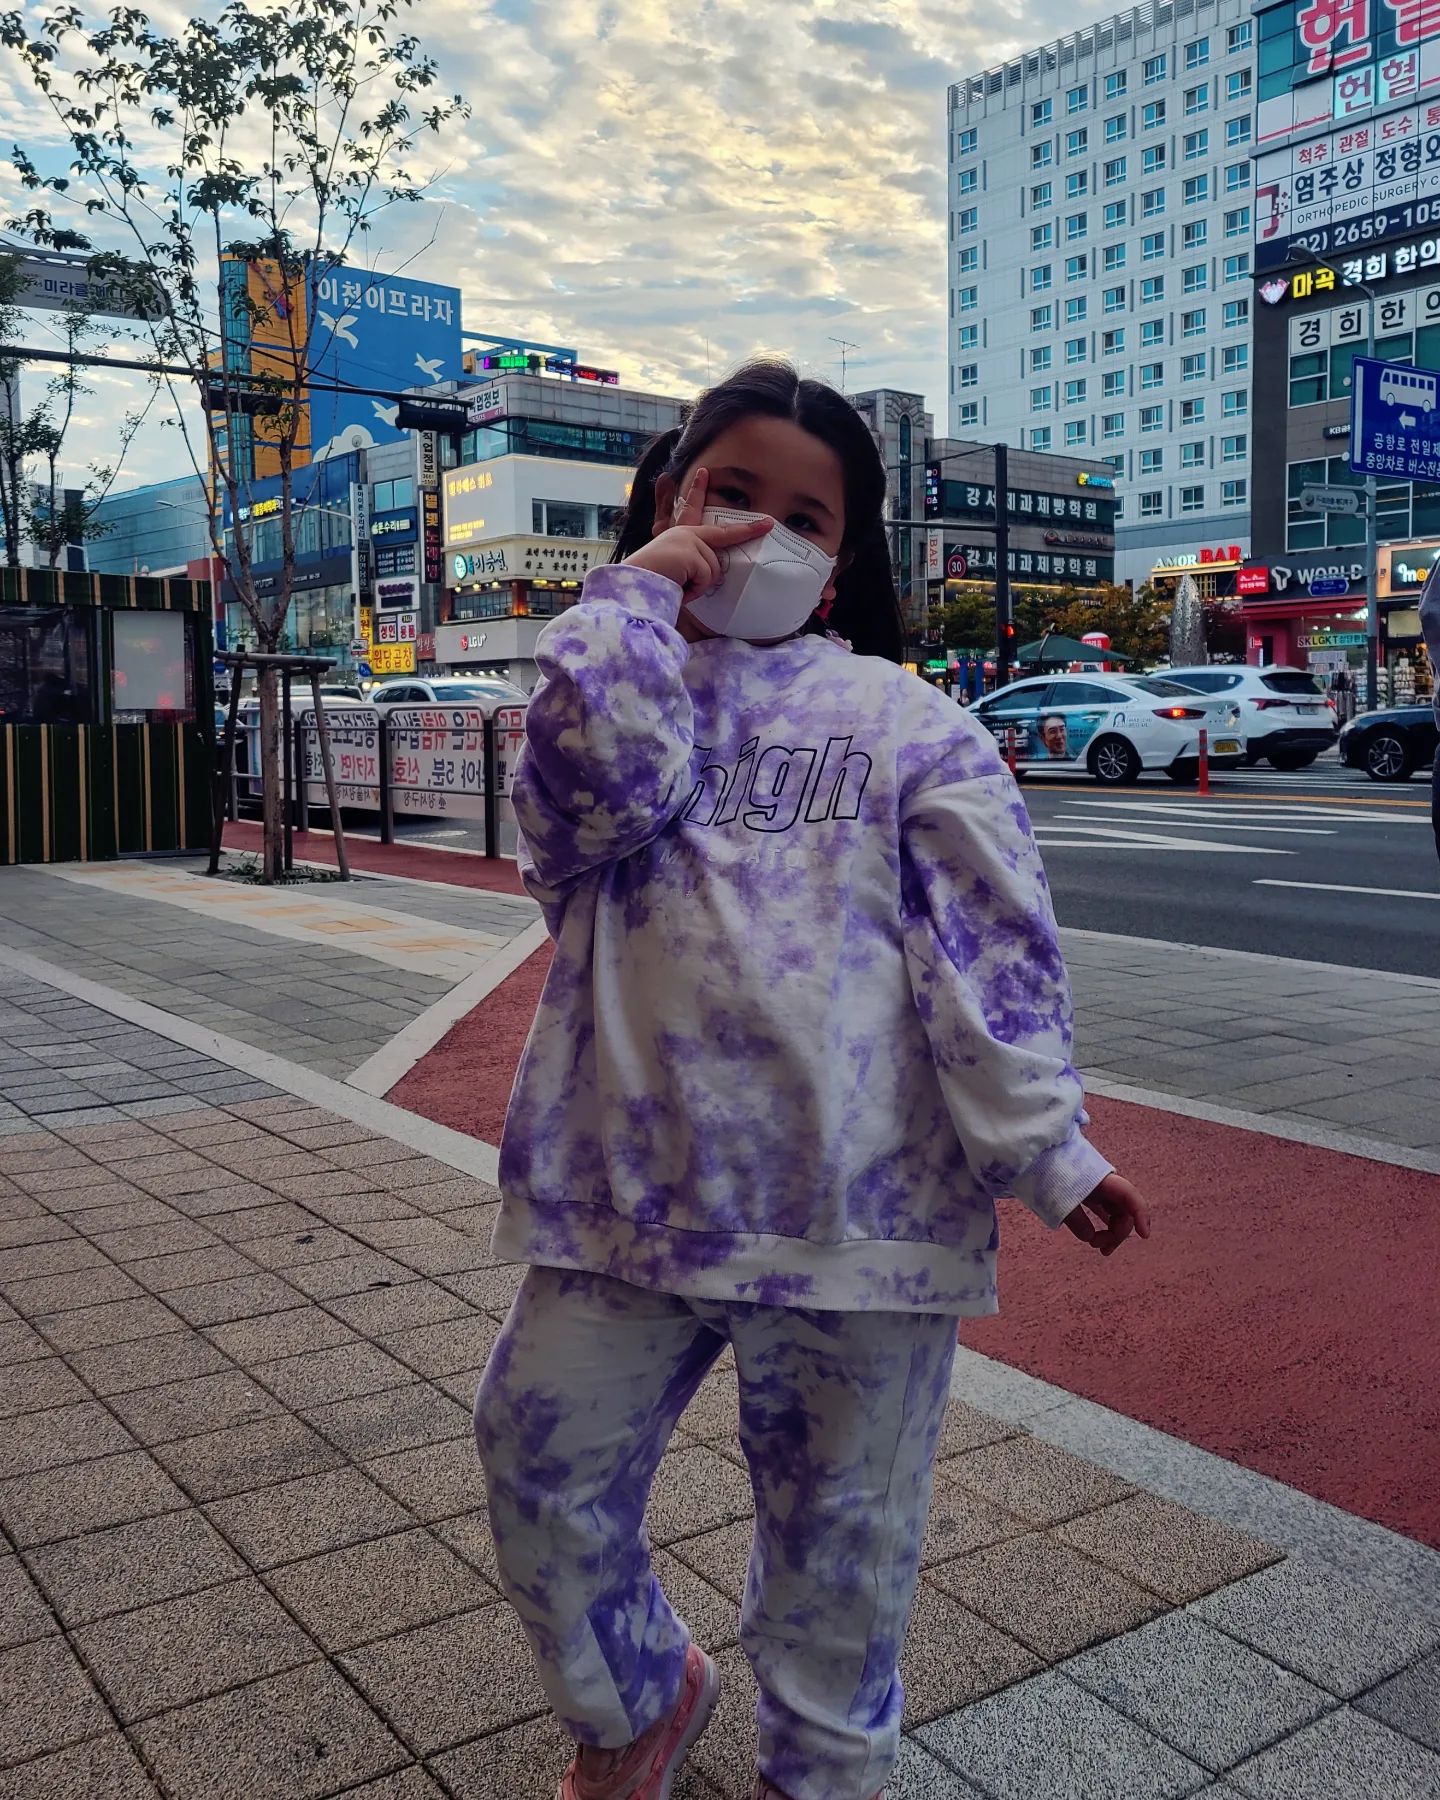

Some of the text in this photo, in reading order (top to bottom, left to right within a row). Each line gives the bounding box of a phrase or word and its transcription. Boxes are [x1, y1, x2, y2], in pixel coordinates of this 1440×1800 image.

[1339, 56, 1417, 112] 헌혈
[1298, 143, 1328, 164] 척추
[1339, 129, 1369, 154] 관절
[1381, 115, 1413, 141] 도수
[1295, 156, 1364, 205] 염주상
[1297, 194, 1369, 224] ORTHOPEDIC
[1373, 178, 1427, 204] SURGERY
[1293, 268, 1335, 298] 마곡
[1342, 252, 1387, 286] 경희
[319, 276, 454, 326] 이천이프라자
[1365, 452, 1405, 471] 중앙차로
[1374, 433, 1406, 451] 공항로
[951, 561, 962, 573] 30
[1155, 545, 1242, 568] AMOR BAR
[381, 624, 395, 639] 성인
[374, 647, 412, 669] 원당곱창
[676, 735, 873, 833] high
